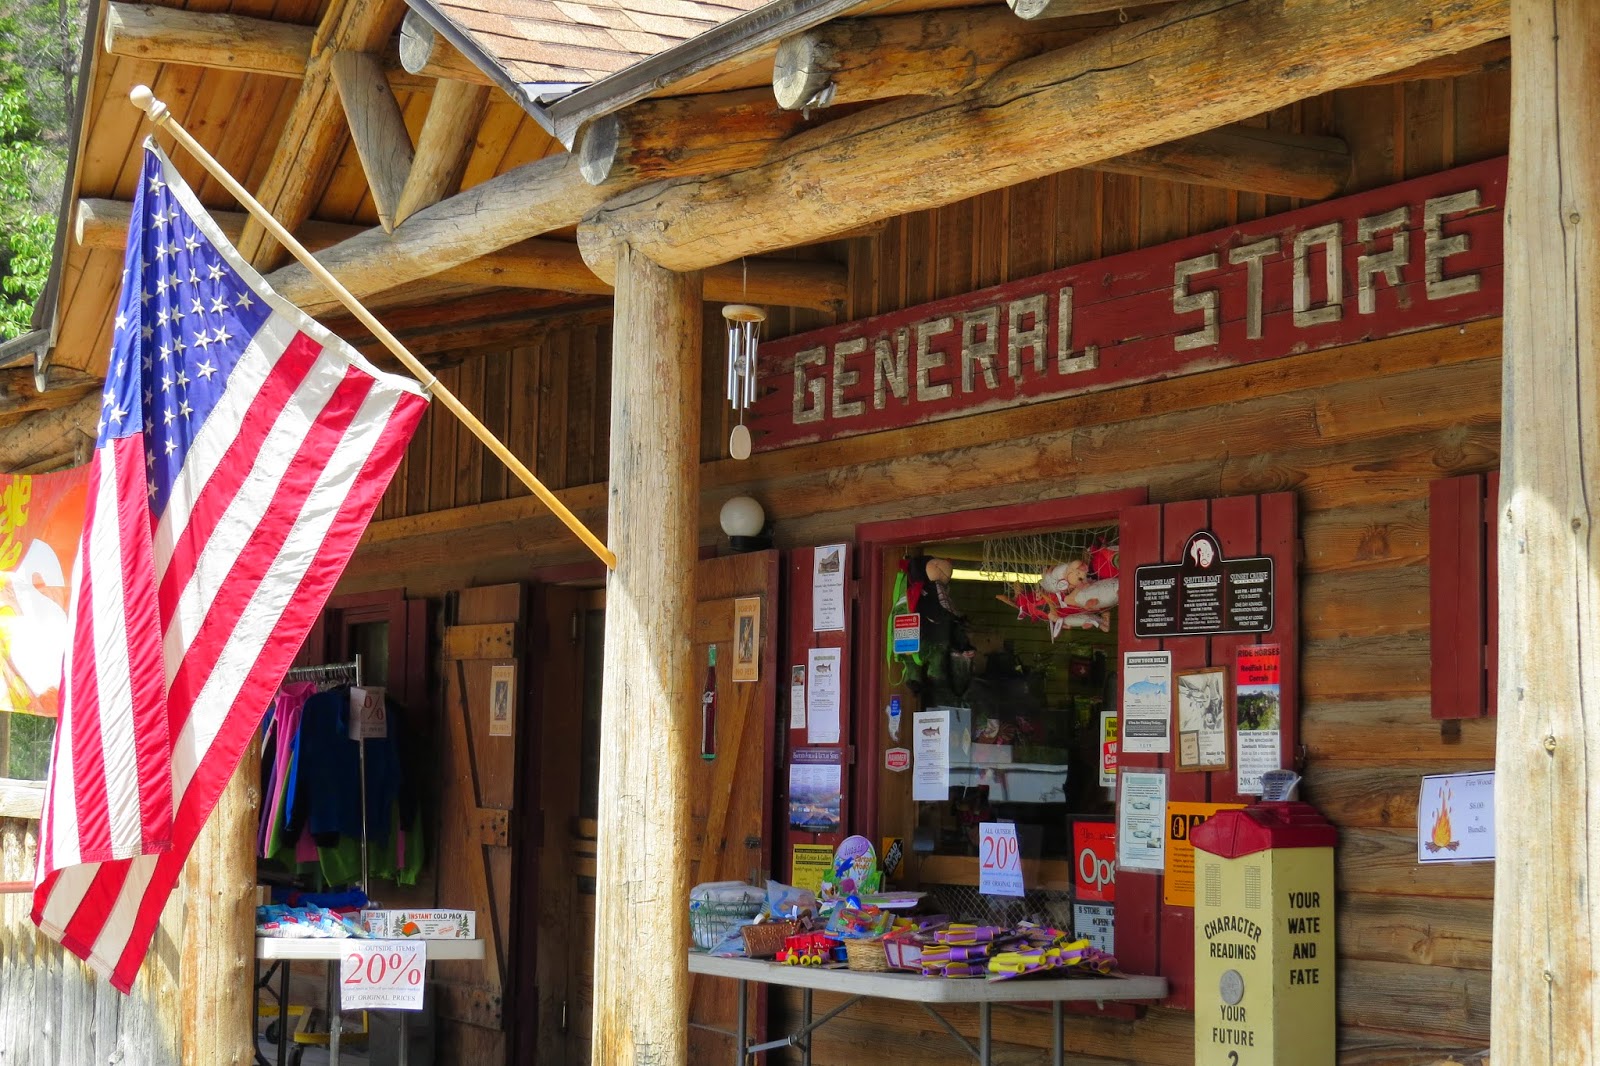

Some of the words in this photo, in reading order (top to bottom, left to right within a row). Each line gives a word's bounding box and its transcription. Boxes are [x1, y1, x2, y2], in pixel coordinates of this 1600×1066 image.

[792, 286, 1099, 425] GENERAL
[1173, 189, 1482, 352] STORE
[1164, 578, 1176, 586] LAKE
[1183, 576, 1206, 586] SHUTTLE
[1207, 574, 1222, 584] BOAT
[1230, 572, 1249, 582] SUNSET
[1250, 572, 1268, 580] CRUISE
[895, 628, 919, 639] MAPS
[1254, 648, 1280, 656] HORSES
[1240, 777, 1260, 786] 208.77
[1288, 892, 1320, 909] YOUR
[1084, 906, 1100, 915] STORE
[1204, 916, 1262, 943] CHARACTER
[1288, 917, 1320, 934] WATE
[1210, 942, 1256, 960] READINGS
[1293, 942, 1316, 959] AND
[345, 953, 421, 985] 20%
[1290, 968, 1319, 985] FATE
[1220, 1004, 1246, 1022] YOUR
[1212, 1028, 1254, 1047] FUTURE
